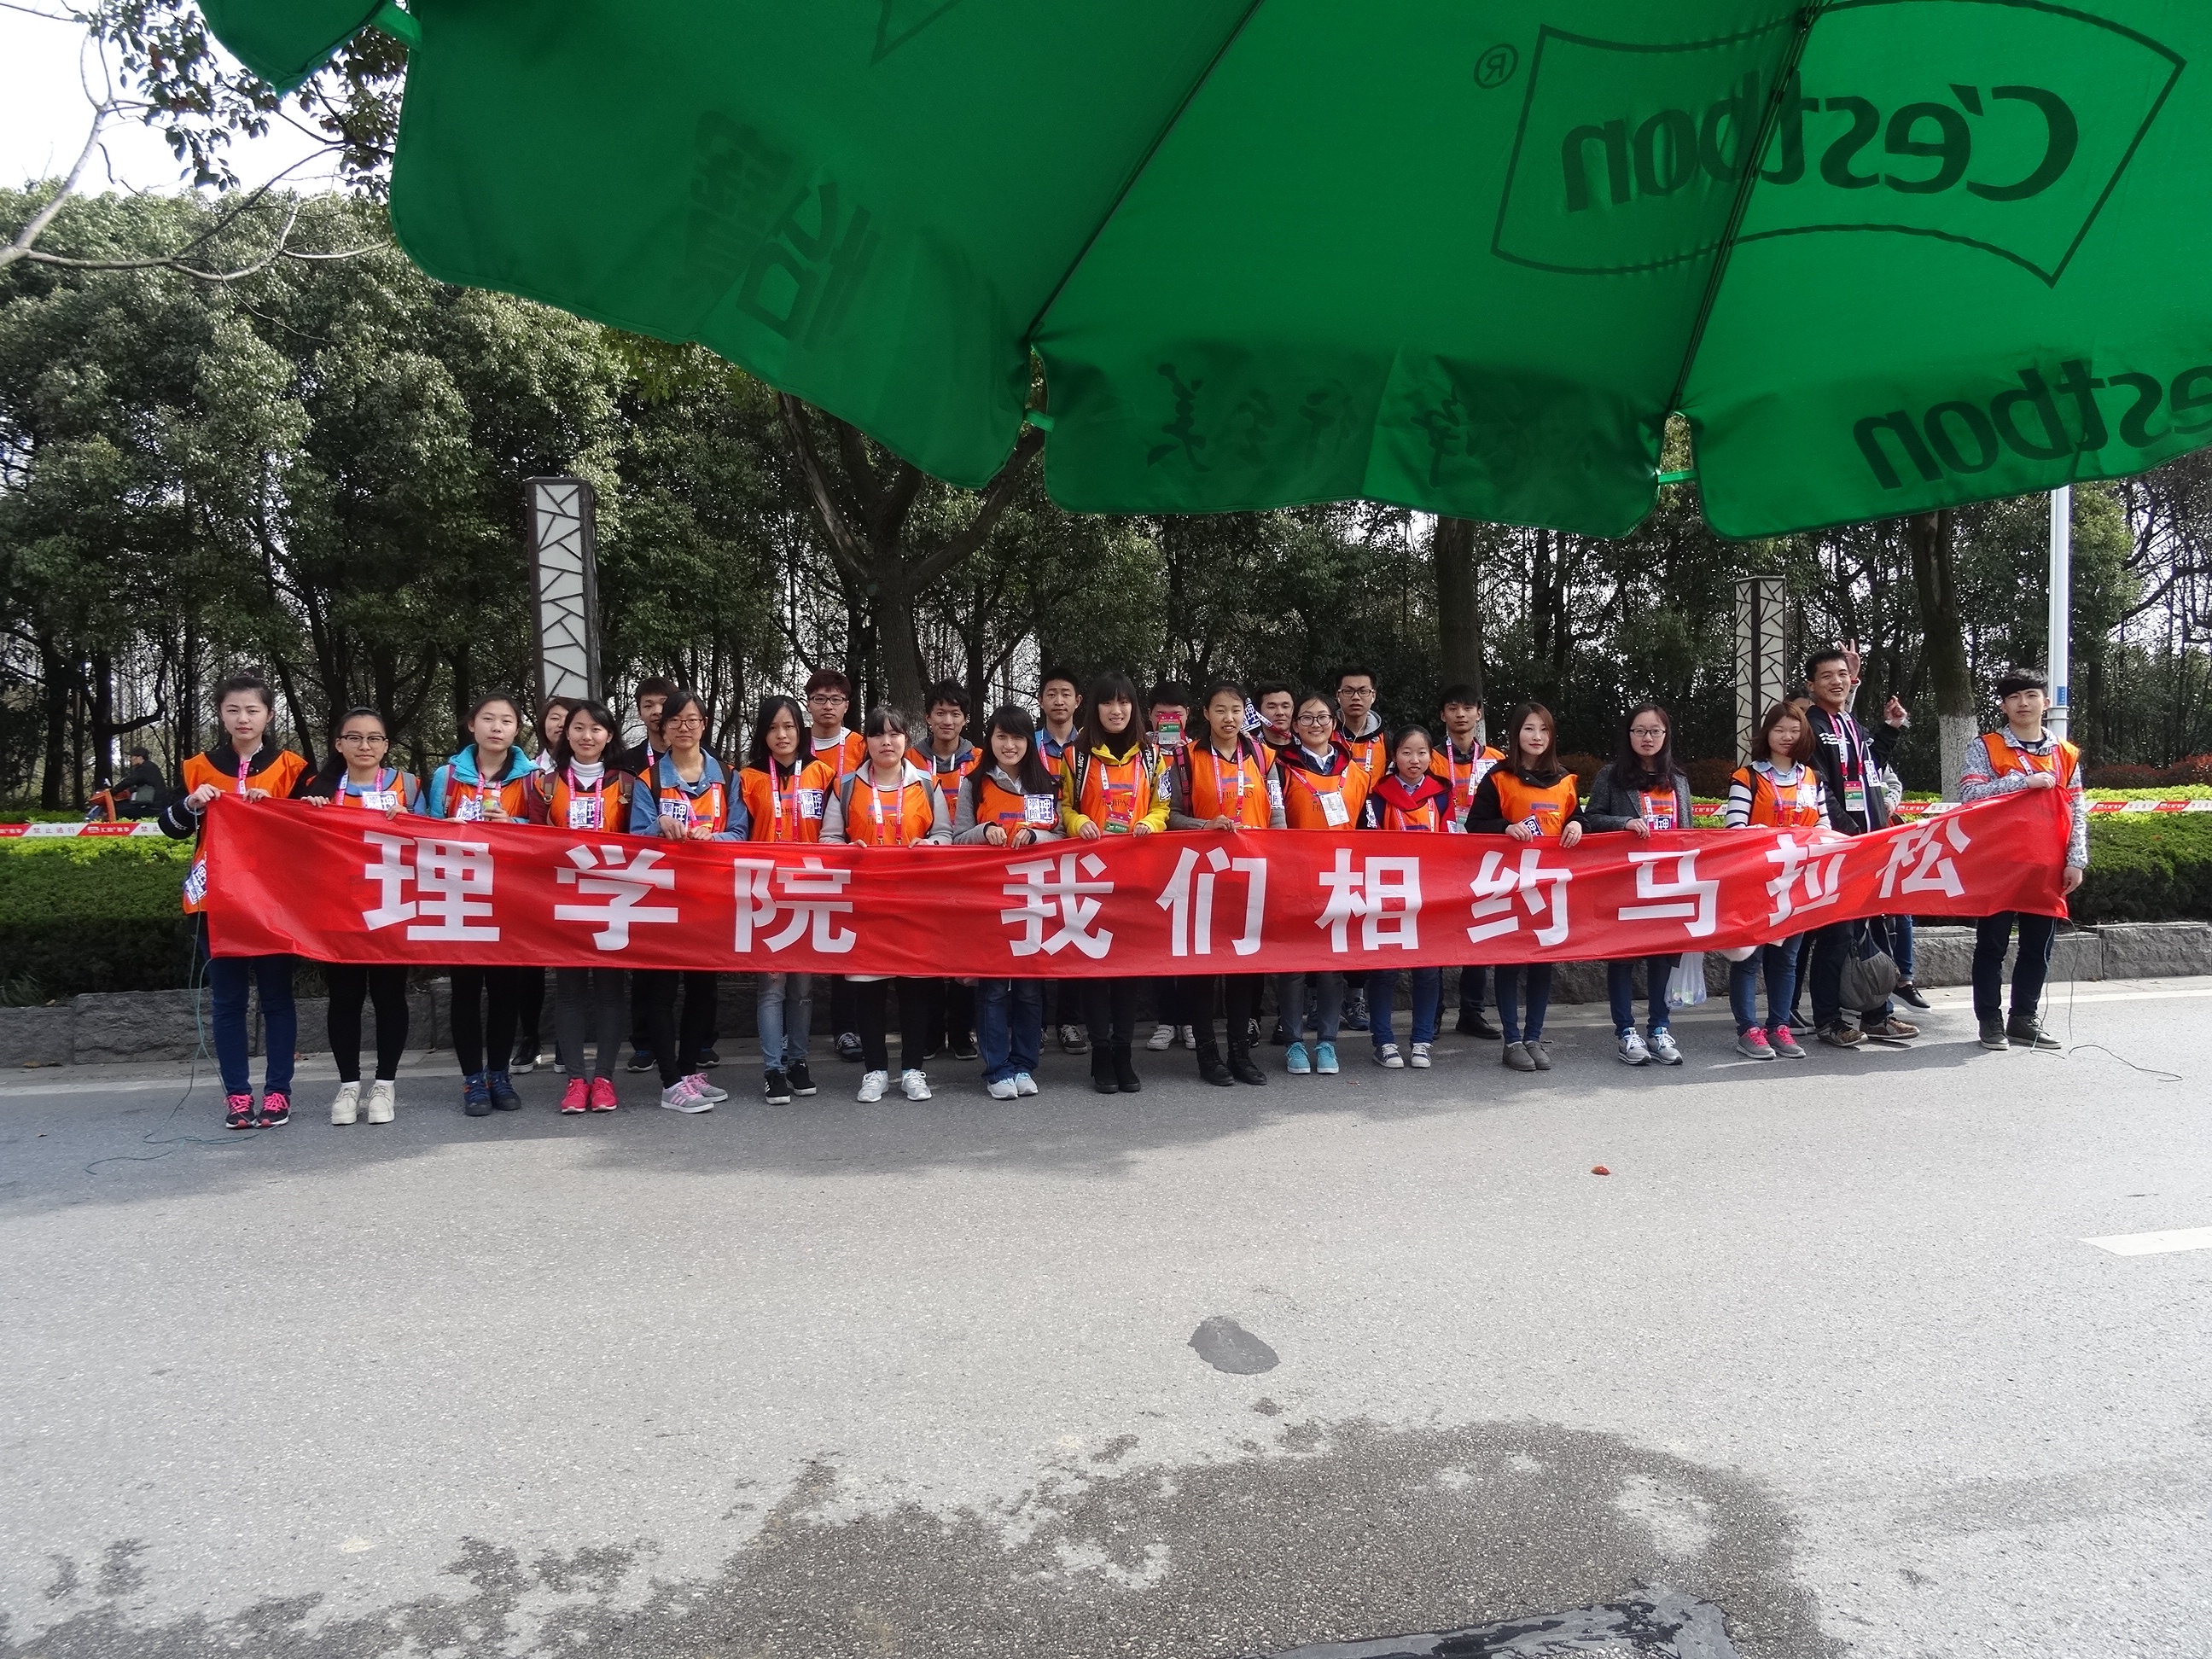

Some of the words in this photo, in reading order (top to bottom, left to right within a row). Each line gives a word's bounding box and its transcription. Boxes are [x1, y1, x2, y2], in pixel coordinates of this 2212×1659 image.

[363, 830, 856, 953] 理学院
[1001, 816, 1971, 958] 我们相约马拉松
